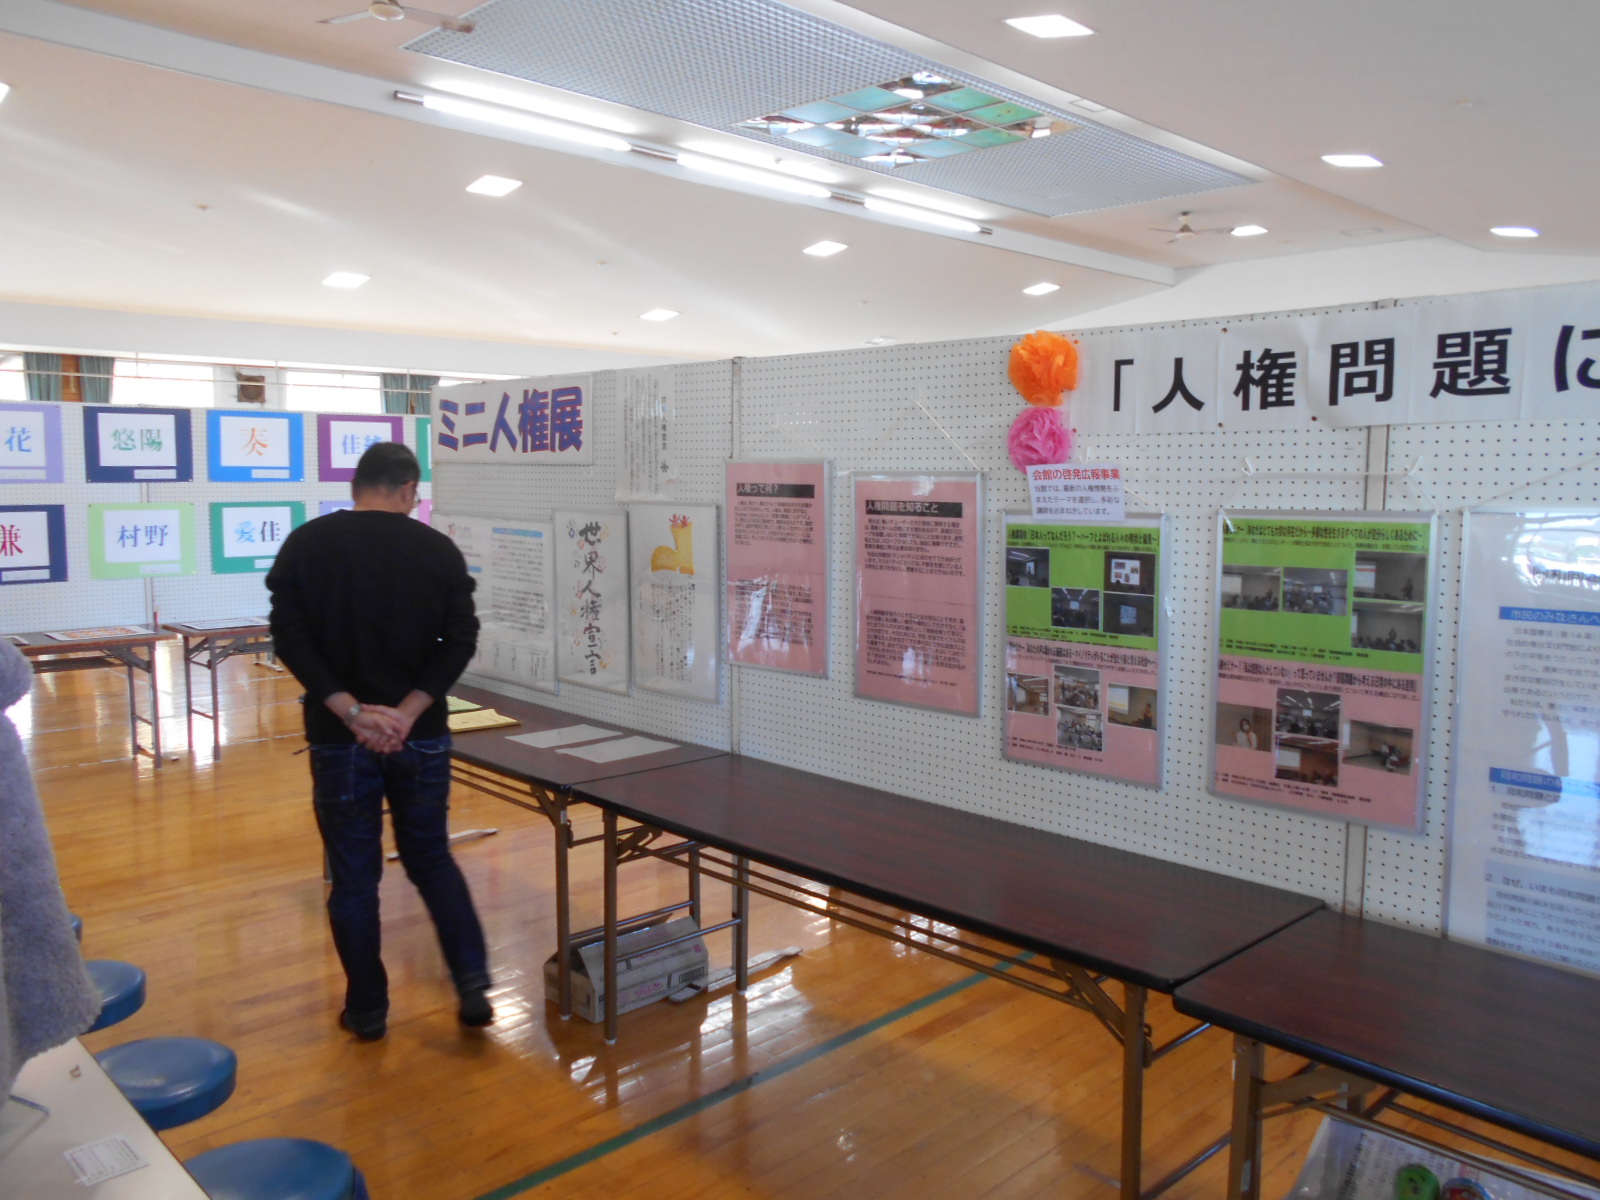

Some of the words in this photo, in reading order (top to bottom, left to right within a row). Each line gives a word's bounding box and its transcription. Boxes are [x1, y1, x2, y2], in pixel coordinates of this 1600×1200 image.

[438, 386, 584, 453] ミニ人権展
[4, 426, 32, 453] 花
[111, 427, 164, 453] 悠陽
[240, 427, 268, 457] 奏
[1033, 468, 1121, 481] 会館の啓発広報事業
[117, 524, 169, 548] 村野
[235, 520, 281, 544] 愛佳
[579, 521, 604, 676] 世界人権宣言
